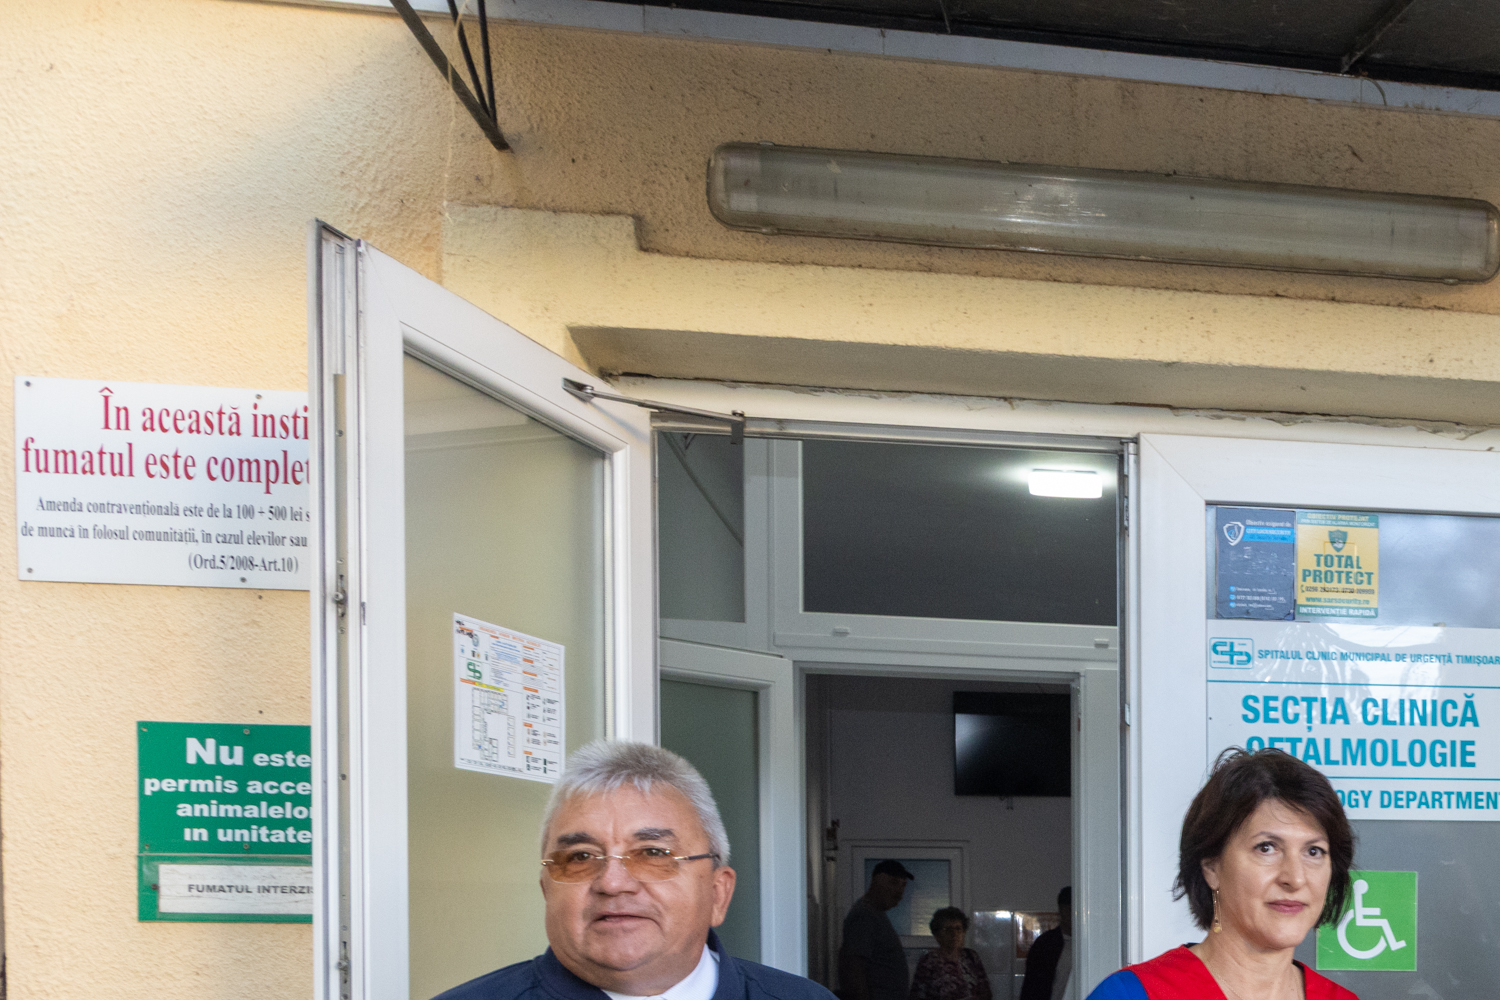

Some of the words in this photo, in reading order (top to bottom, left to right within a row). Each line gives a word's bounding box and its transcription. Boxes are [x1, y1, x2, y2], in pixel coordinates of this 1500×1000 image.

[98, 386, 131, 431] În
[141, 403, 241, 436] această
[22, 436, 135, 477] fumatul
[145, 448, 196, 480] este
[36, 497, 83, 512] Amenda
[183, 504, 204, 517] este
[207, 503, 220, 518] de
[222, 504, 233, 518] la
[236, 504, 255, 520] 100
[268, 505, 287, 521] 500
[290, 507, 303, 522] lei
[21, 521, 34, 537] de
[37, 525, 75, 538] muncă
[78, 525, 89, 539] în
[92, 524, 129, 540] folosul
[201, 530, 212, 543] în
[215, 530, 244, 544] cazul
[246, 531, 286, 546] elevilor
[289, 536, 308, 547] sau
[1314, 553, 1362, 569] TOTAL
[1302, 569, 1374, 585] PROTECT
[1258, 649, 1302, 660] SPITALUL
[1306, 651, 1337, 660] CLINIC
[1340, 652, 1392, 662] MUNICIPAL
[1395, 653, 1407, 662] DE
[1241, 694, 1350, 732] SECȚIA
[1362, 693, 1479, 727] CLINICĂ
[186, 737, 244, 766] Nu
[253, 751, 311, 767] este
[144, 775, 239, 795] permis
[217, 825, 312, 843] unitate
[188, 884, 252, 893] FUMATUL
